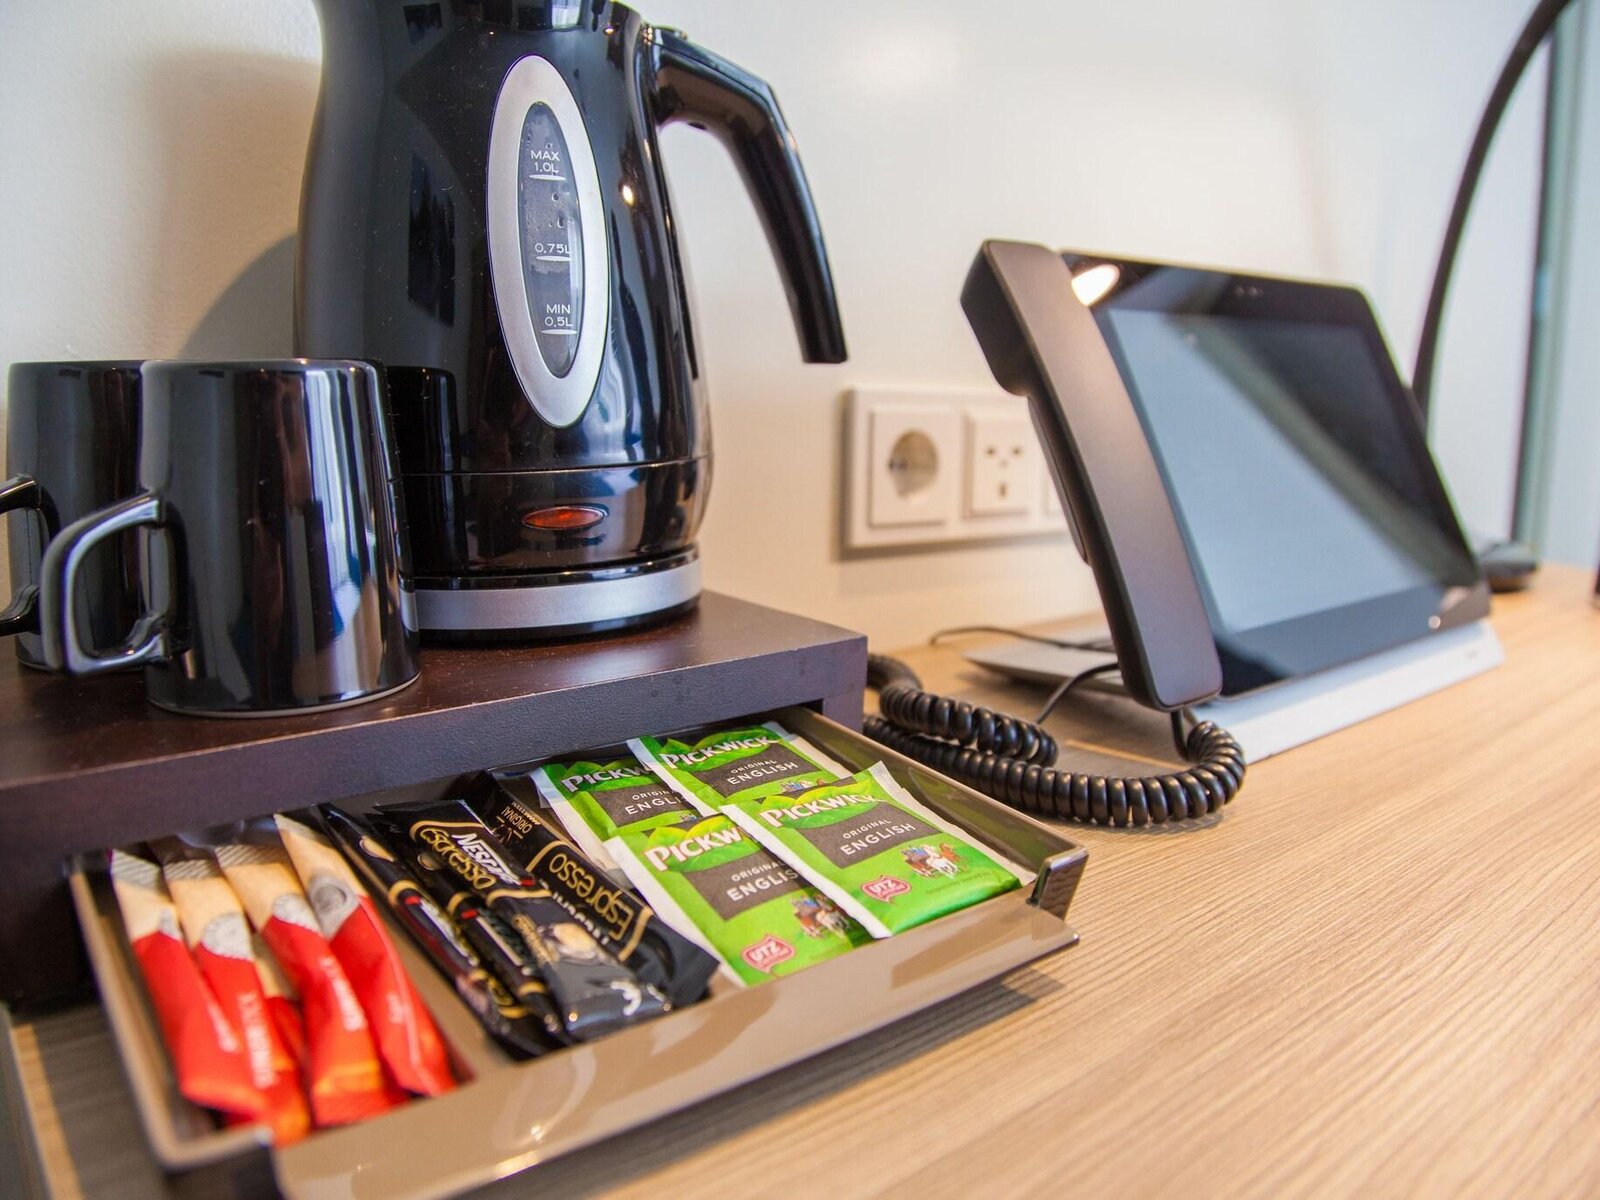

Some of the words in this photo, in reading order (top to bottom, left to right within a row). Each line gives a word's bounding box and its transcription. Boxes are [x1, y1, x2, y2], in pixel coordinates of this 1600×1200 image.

[530, 149, 560, 162] MAX
[534, 161, 560, 173] 1.0L
[534, 242, 572, 254] 0.75L
[546, 303, 571, 315] MIN
[544, 316, 573, 327] 0.5L
[659, 736, 779, 769] PICKWICK
[726, 761, 800, 786] ENGLISH
[730, 759, 778, 774] ORIGINAL
[560, 766, 652, 793] PICKW
[631, 788, 675, 801] ORIGIN
[624, 796, 683, 816] ENGLI
[759, 794, 878, 828] PICKWICK
[840, 823, 917, 856] ENGLISH
[842, 819, 892, 840] ORIGINAL
[644, 827, 742, 872] PICKW
[726, 868, 799, 902] ENGLIS
[549, 853, 634, 941] Espresso
